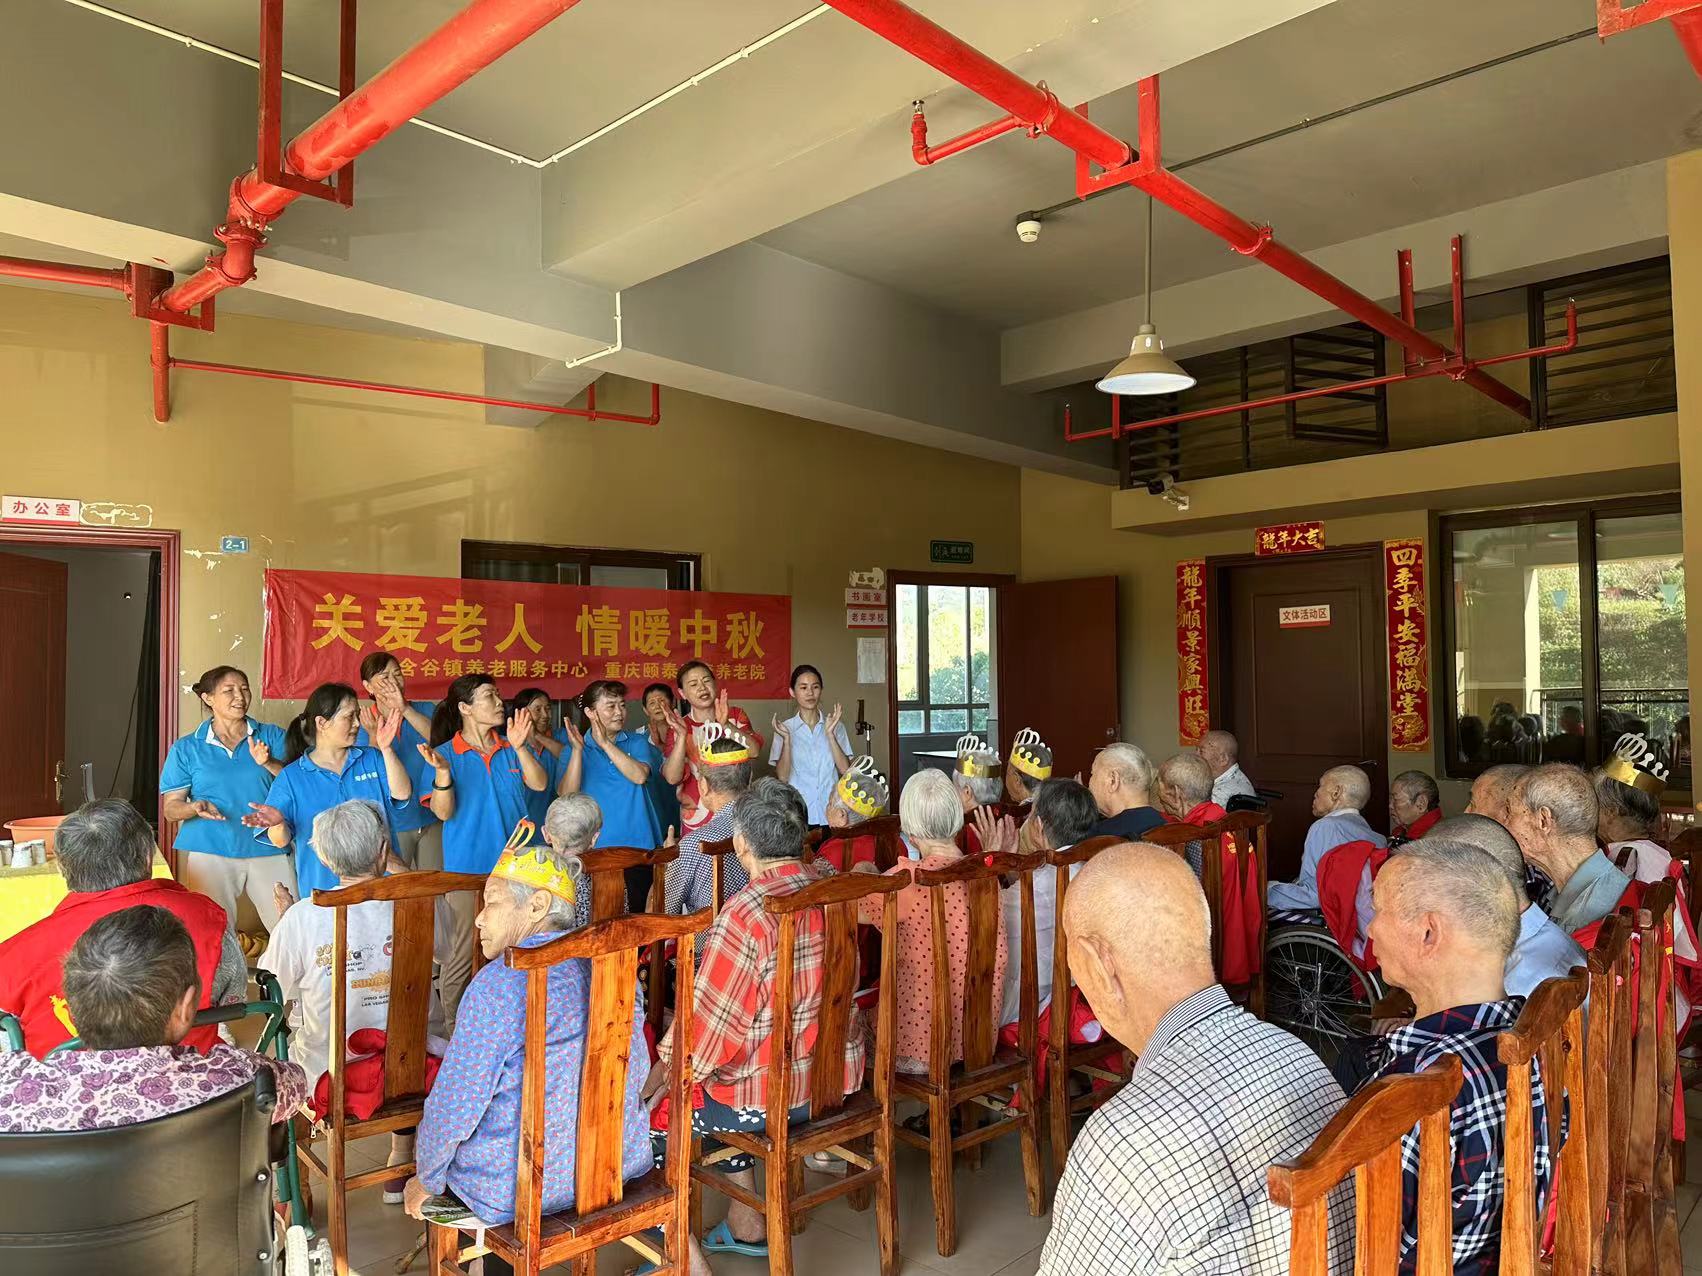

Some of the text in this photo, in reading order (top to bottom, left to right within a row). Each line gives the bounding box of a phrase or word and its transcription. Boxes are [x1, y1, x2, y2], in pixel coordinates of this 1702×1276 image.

[13, 500, 71, 516] 办公室
[225, 539, 245, 550] 2-1
[851, 612, 885, 622] 老年学校
[1282, 608, 1328, 621] 文体活动区
[311, 592, 765, 659] 关爱老人 情暖中秋
[604, 661, 766, 680] 重庆颐泰养老院
